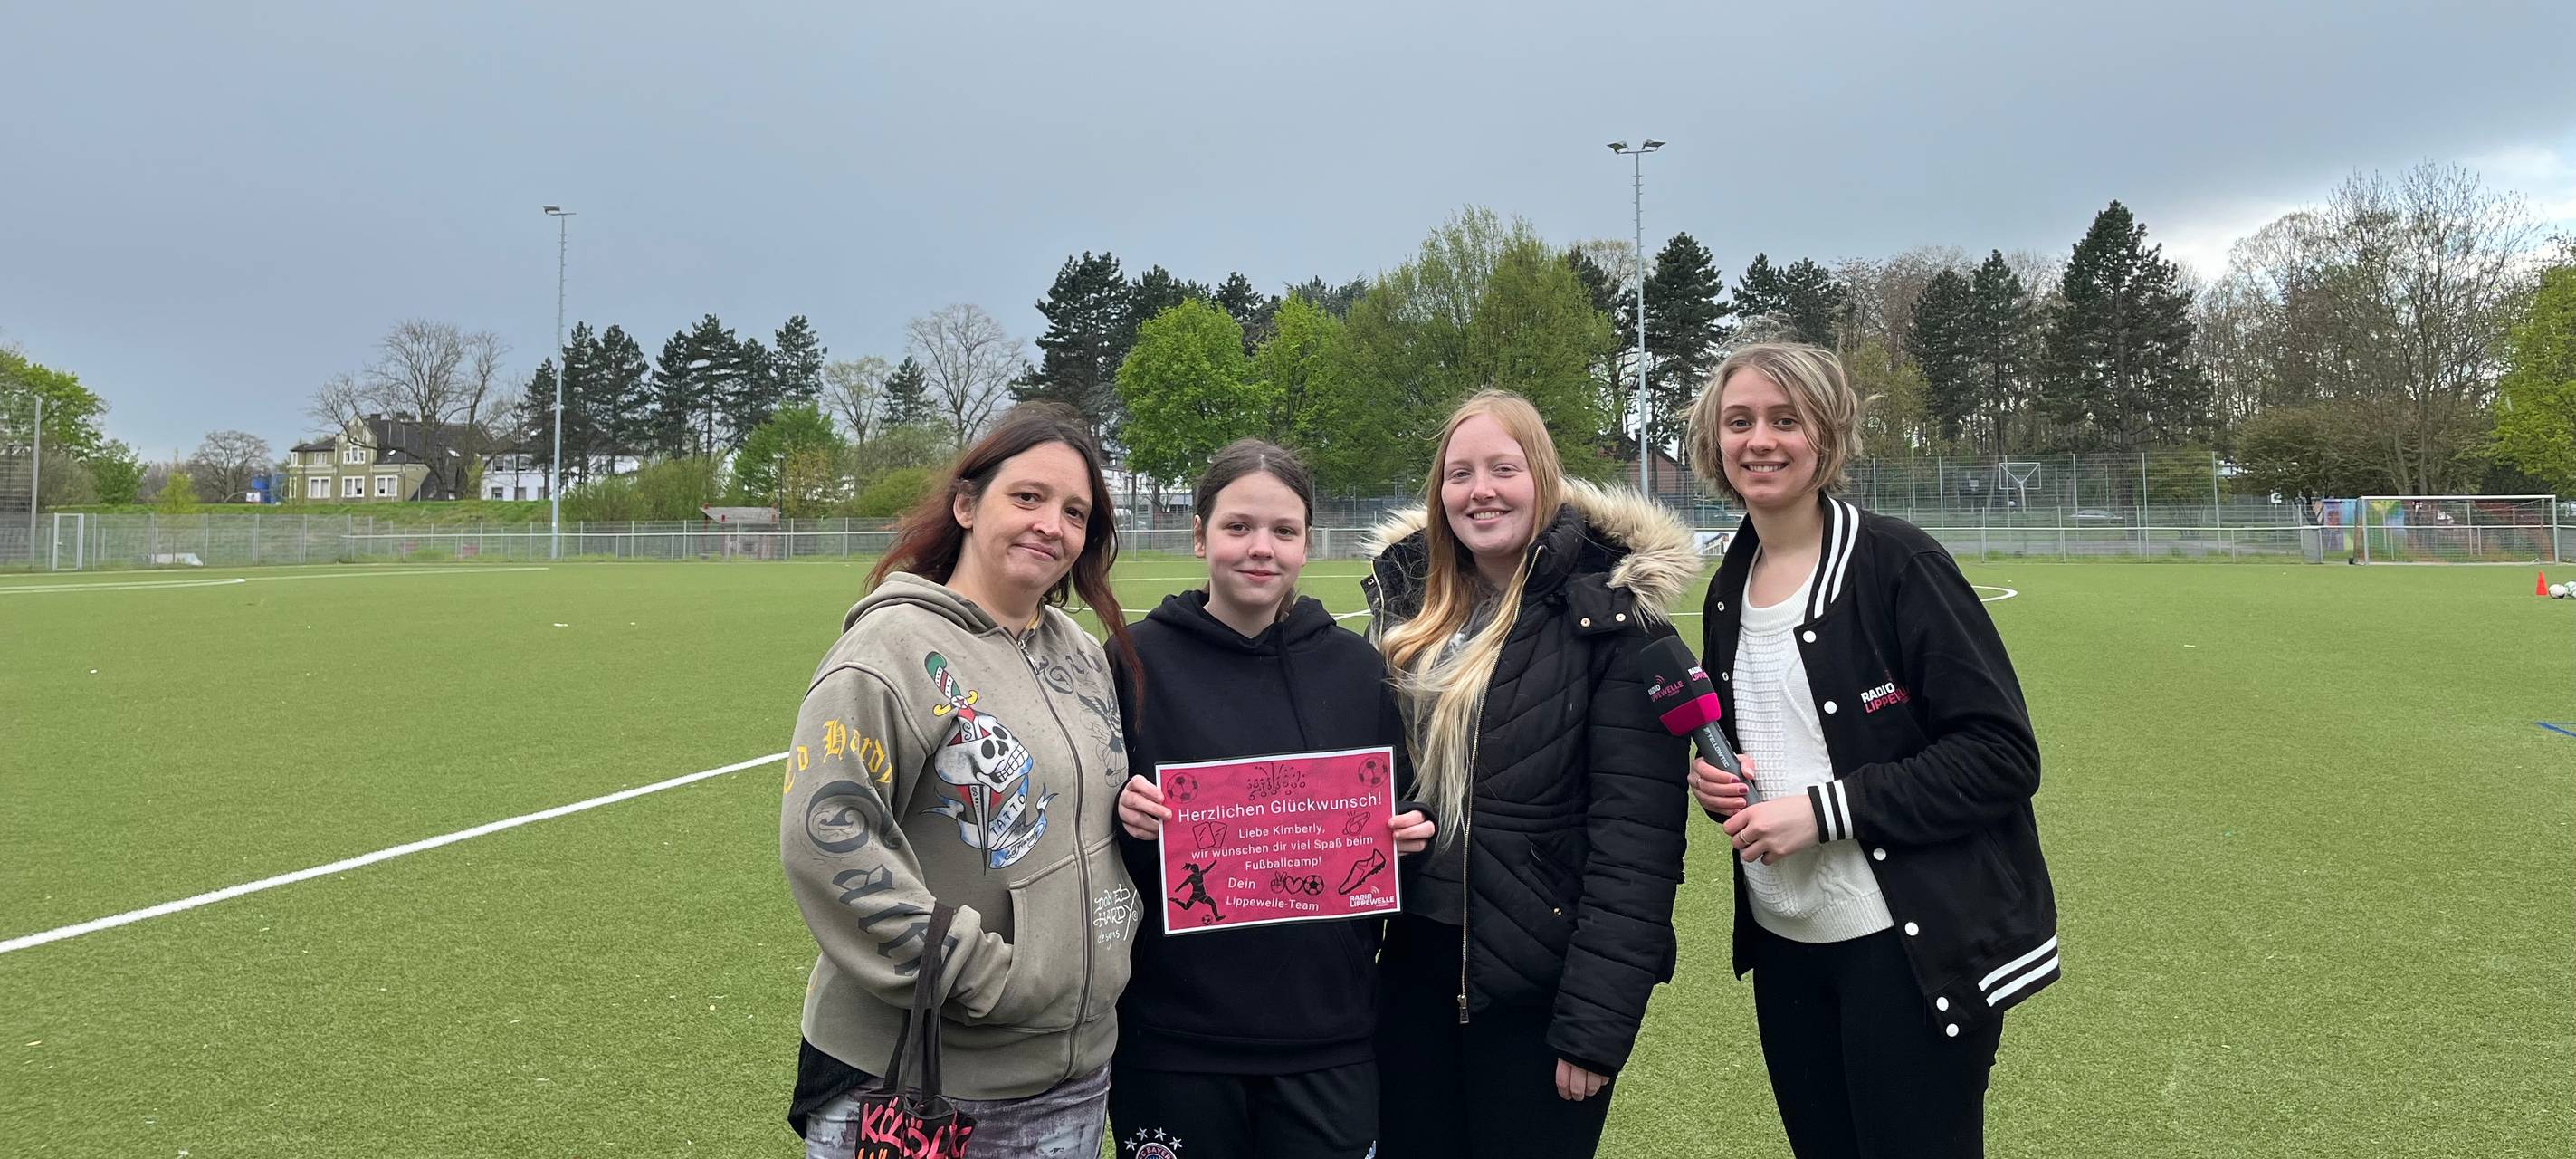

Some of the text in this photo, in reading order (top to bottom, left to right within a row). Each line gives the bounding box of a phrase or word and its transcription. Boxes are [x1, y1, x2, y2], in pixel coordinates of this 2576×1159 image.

[1860, 682, 1895, 704] RADIO
[1707, 733, 1730, 768] YELLOWTEC
[1178, 791, 1383, 823] Herzlichen Glückwunsch!
[1238, 822, 1326, 838] Liebe Kimberly,
[1191, 835, 1373, 860] wir wünschen dir viel Spaß beim
[1227, 877, 1256, 889] Dein
[1226, 895, 1319, 912] Lippewelle-Team
[1350, 893, 1372, 902] RADIO
[1350, 896, 1395, 907] LIPPEWELLE
